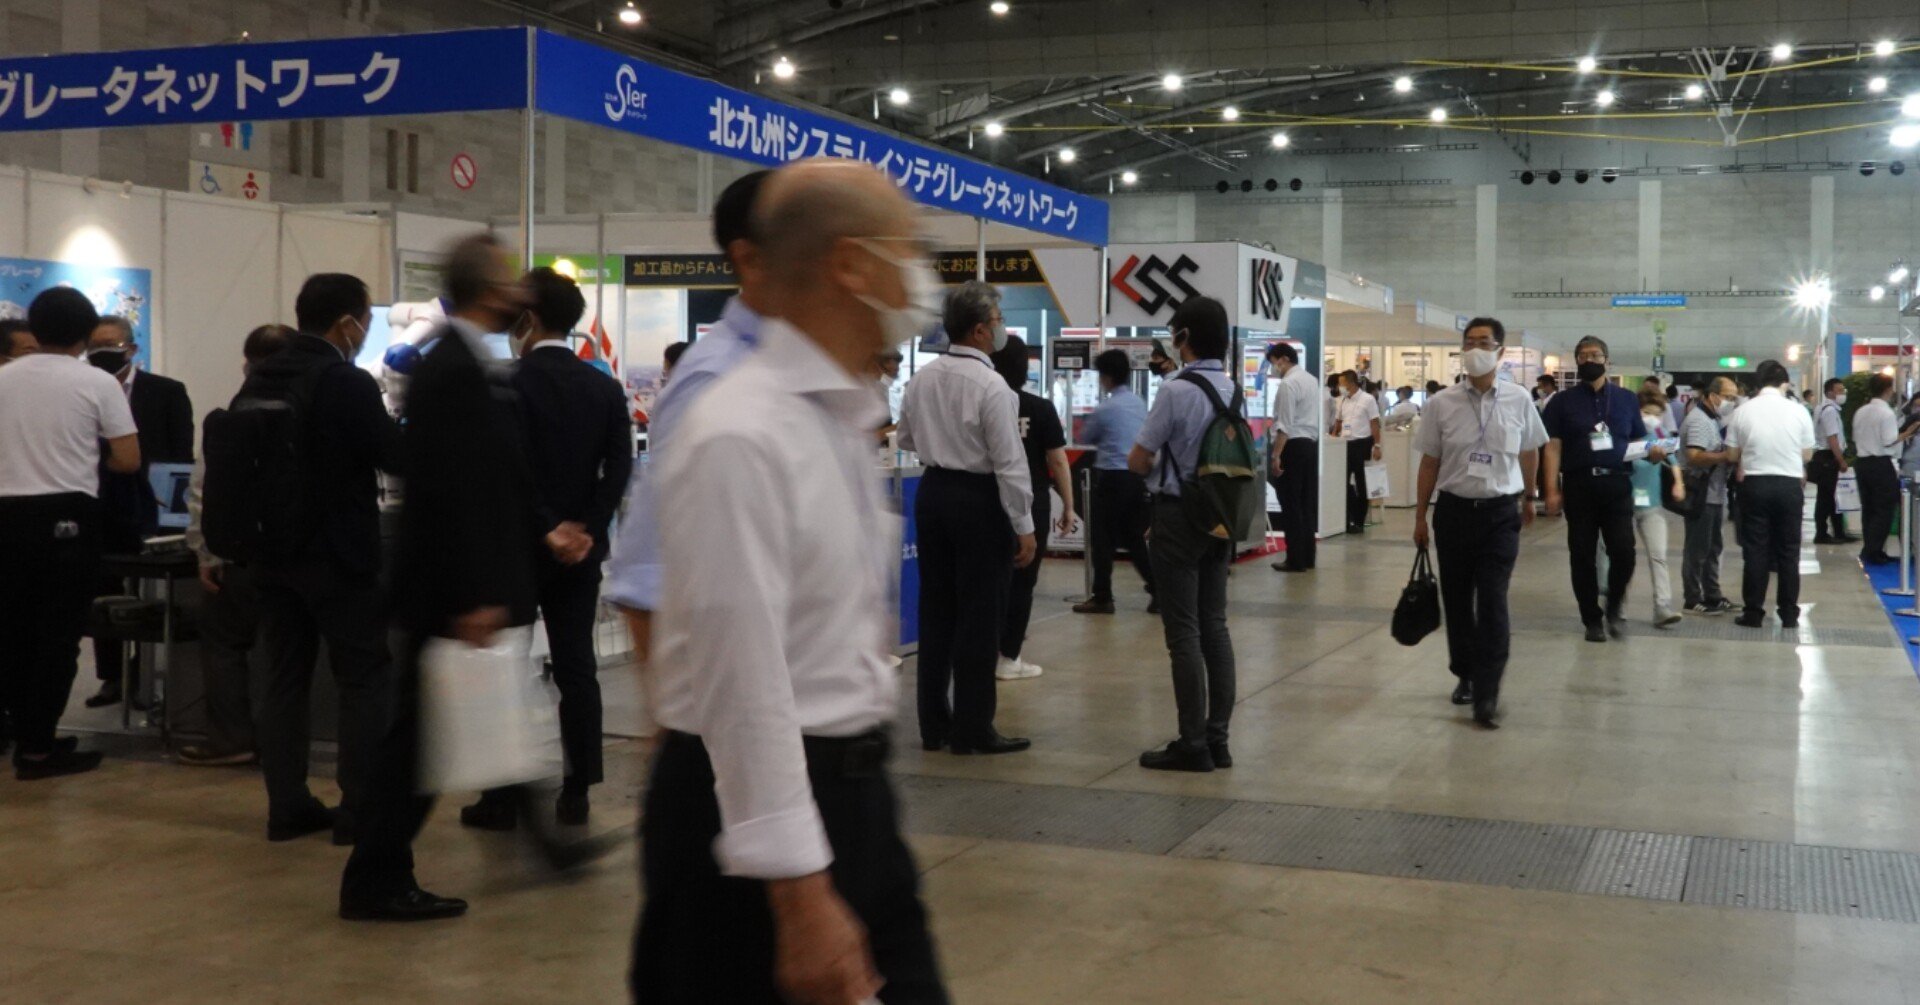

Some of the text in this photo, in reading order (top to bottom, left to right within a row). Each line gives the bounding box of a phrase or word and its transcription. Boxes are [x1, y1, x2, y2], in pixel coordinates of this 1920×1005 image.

[0, 51, 401, 119] グレータネットワーク
[1106, 253, 1201, 316] KSS
